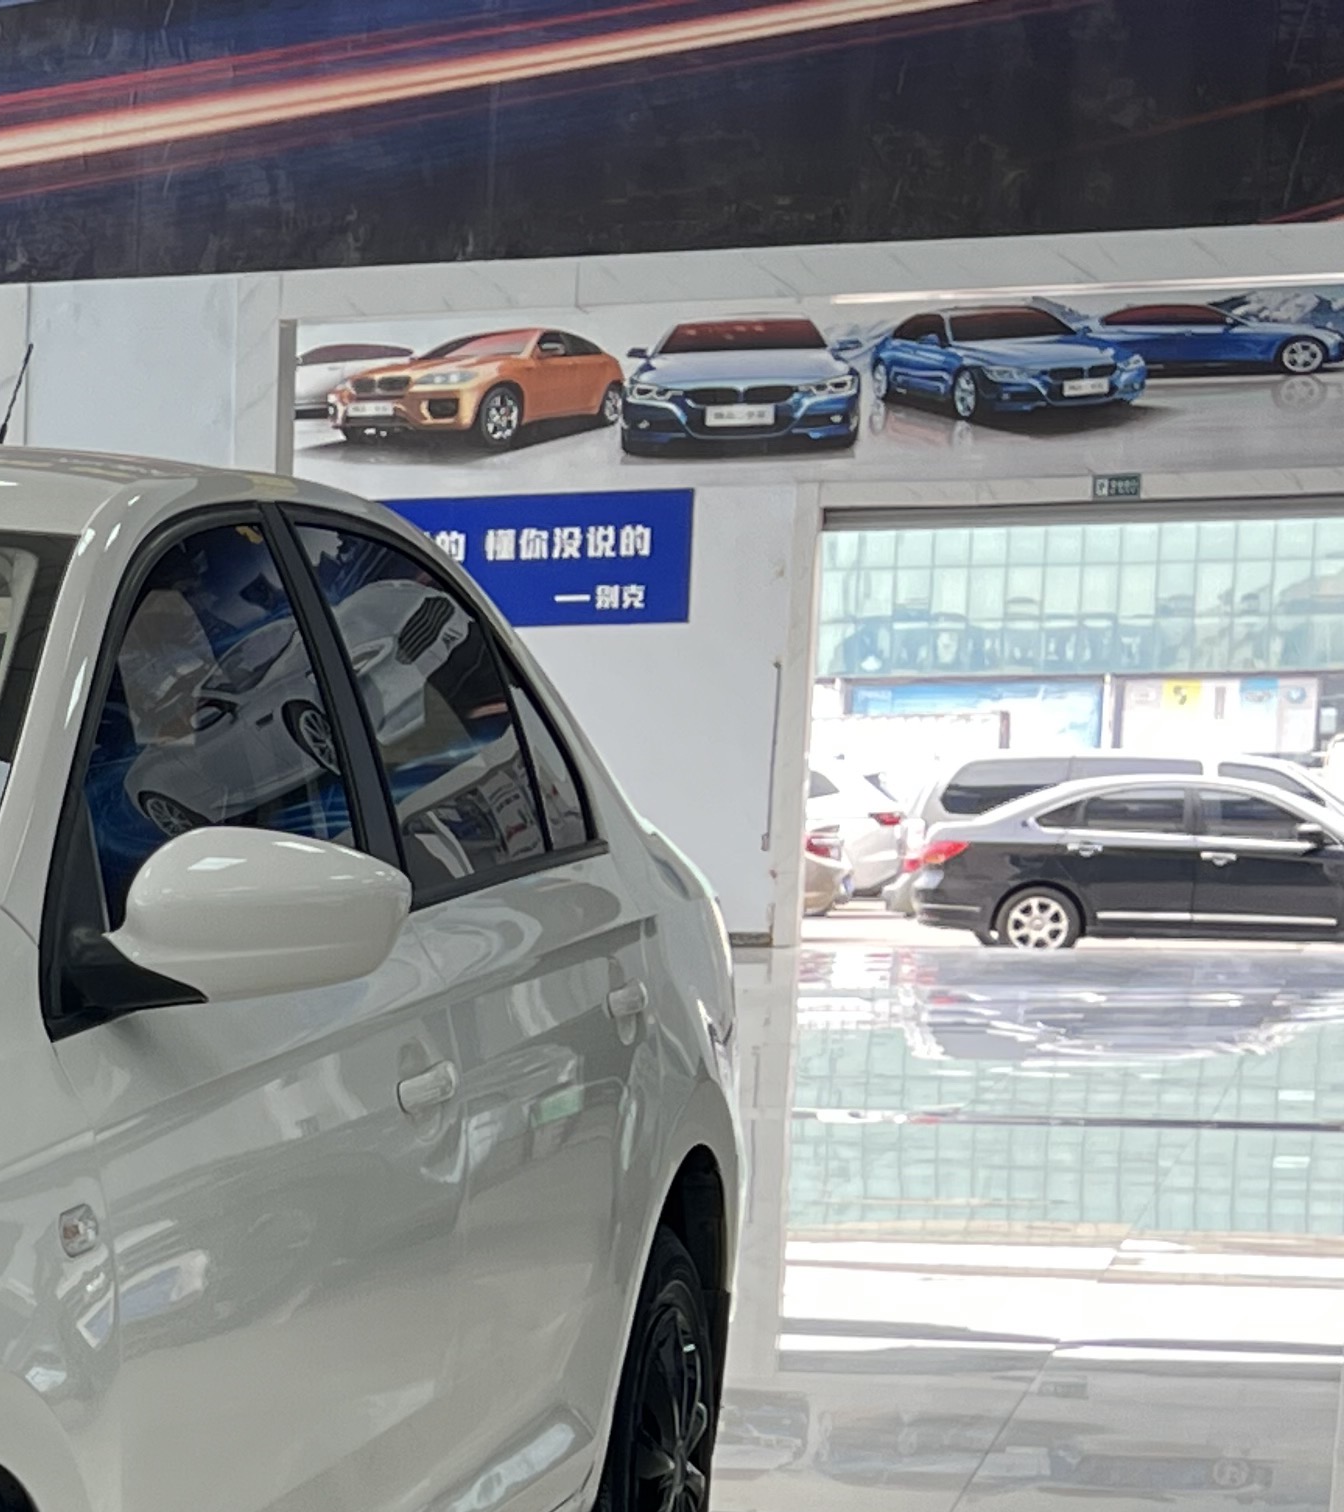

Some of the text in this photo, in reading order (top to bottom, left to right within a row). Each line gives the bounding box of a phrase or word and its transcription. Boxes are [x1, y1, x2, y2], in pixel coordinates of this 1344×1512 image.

[484, 524, 652, 561] 懂你没说的
